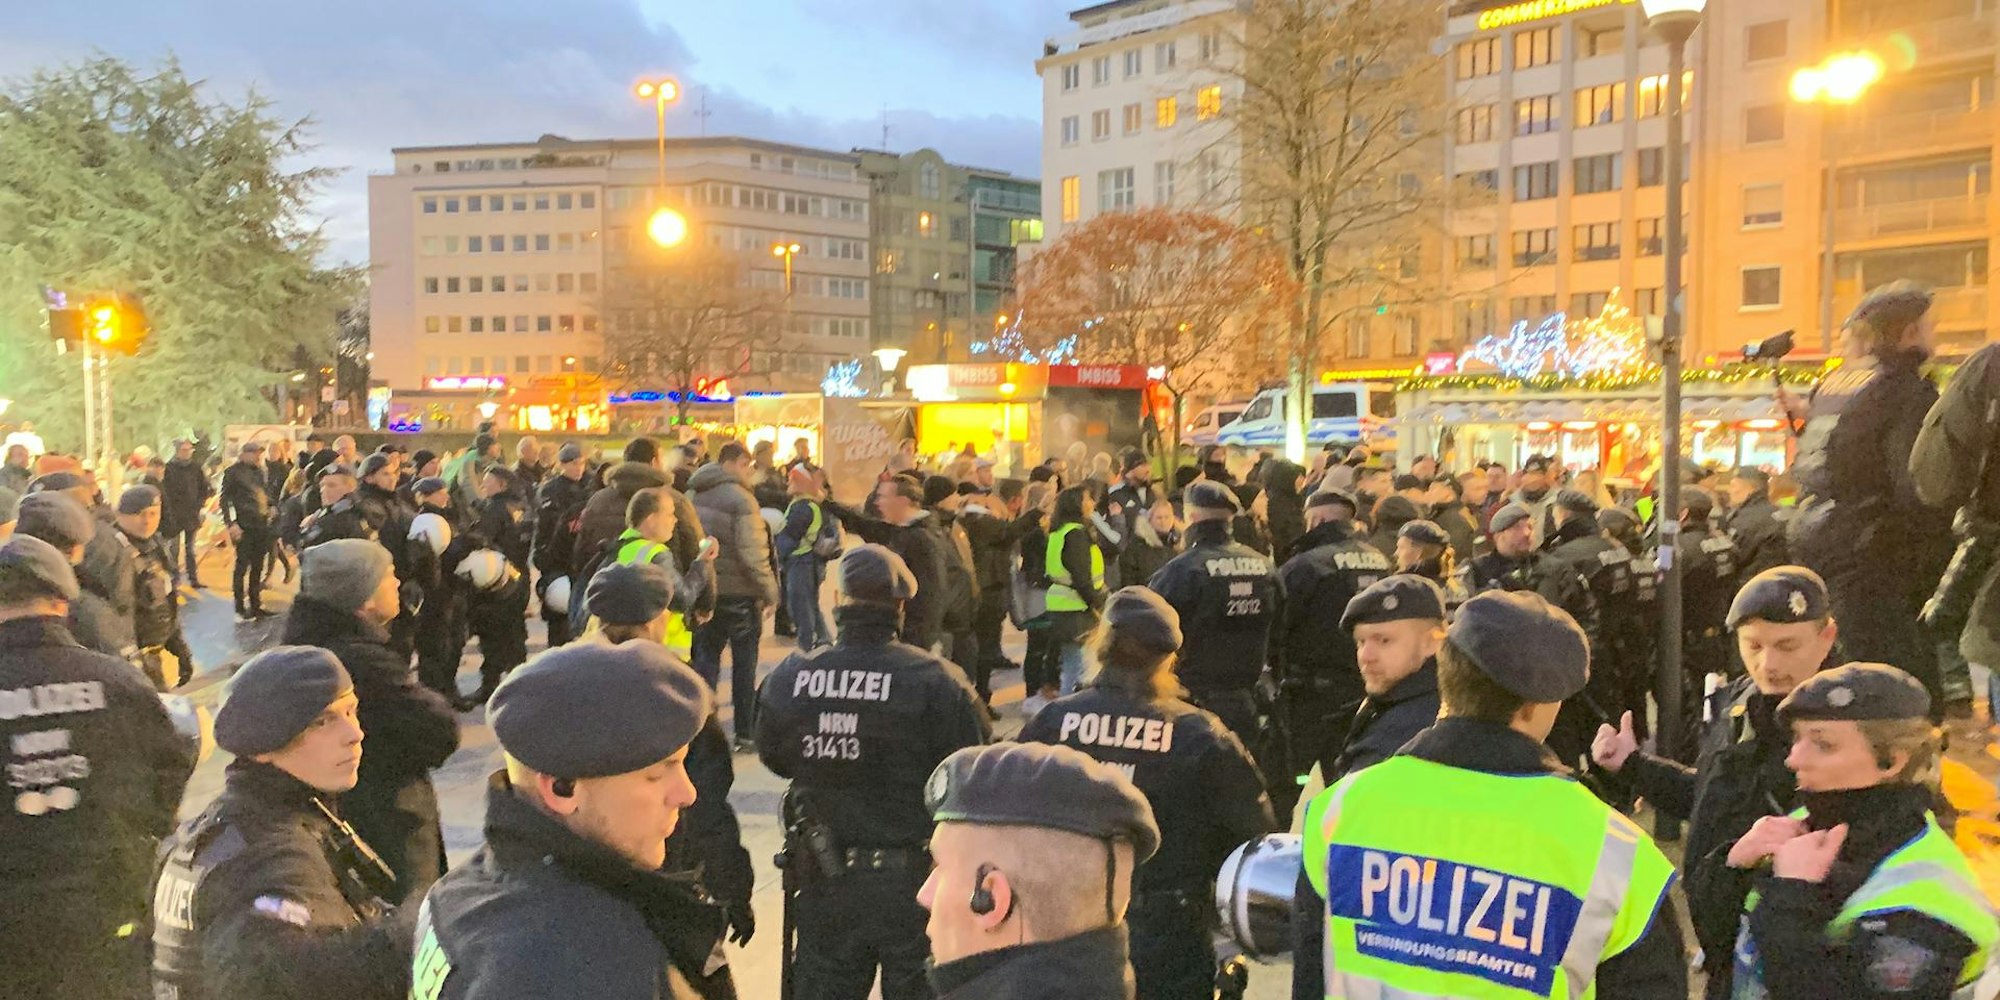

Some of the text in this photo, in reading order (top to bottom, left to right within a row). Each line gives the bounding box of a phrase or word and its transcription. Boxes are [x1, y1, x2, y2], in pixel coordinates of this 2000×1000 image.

[1478, 0, 1613, 30] COMMERZBA
[953, 367, 998, 384] IMBISS
[1076, 367, 1122, 385] IMBISS
[1205, 557, 1269, 577] POLIZEI
[792, 668, 893, 702] POLIZEI
[818, 711, 859, 735] NRW
[1059, 711, 1174, 753] POLIZEI
[801, 734, 861, 760] 31413
[1360, 849, 1552, 957] POLIZEI
